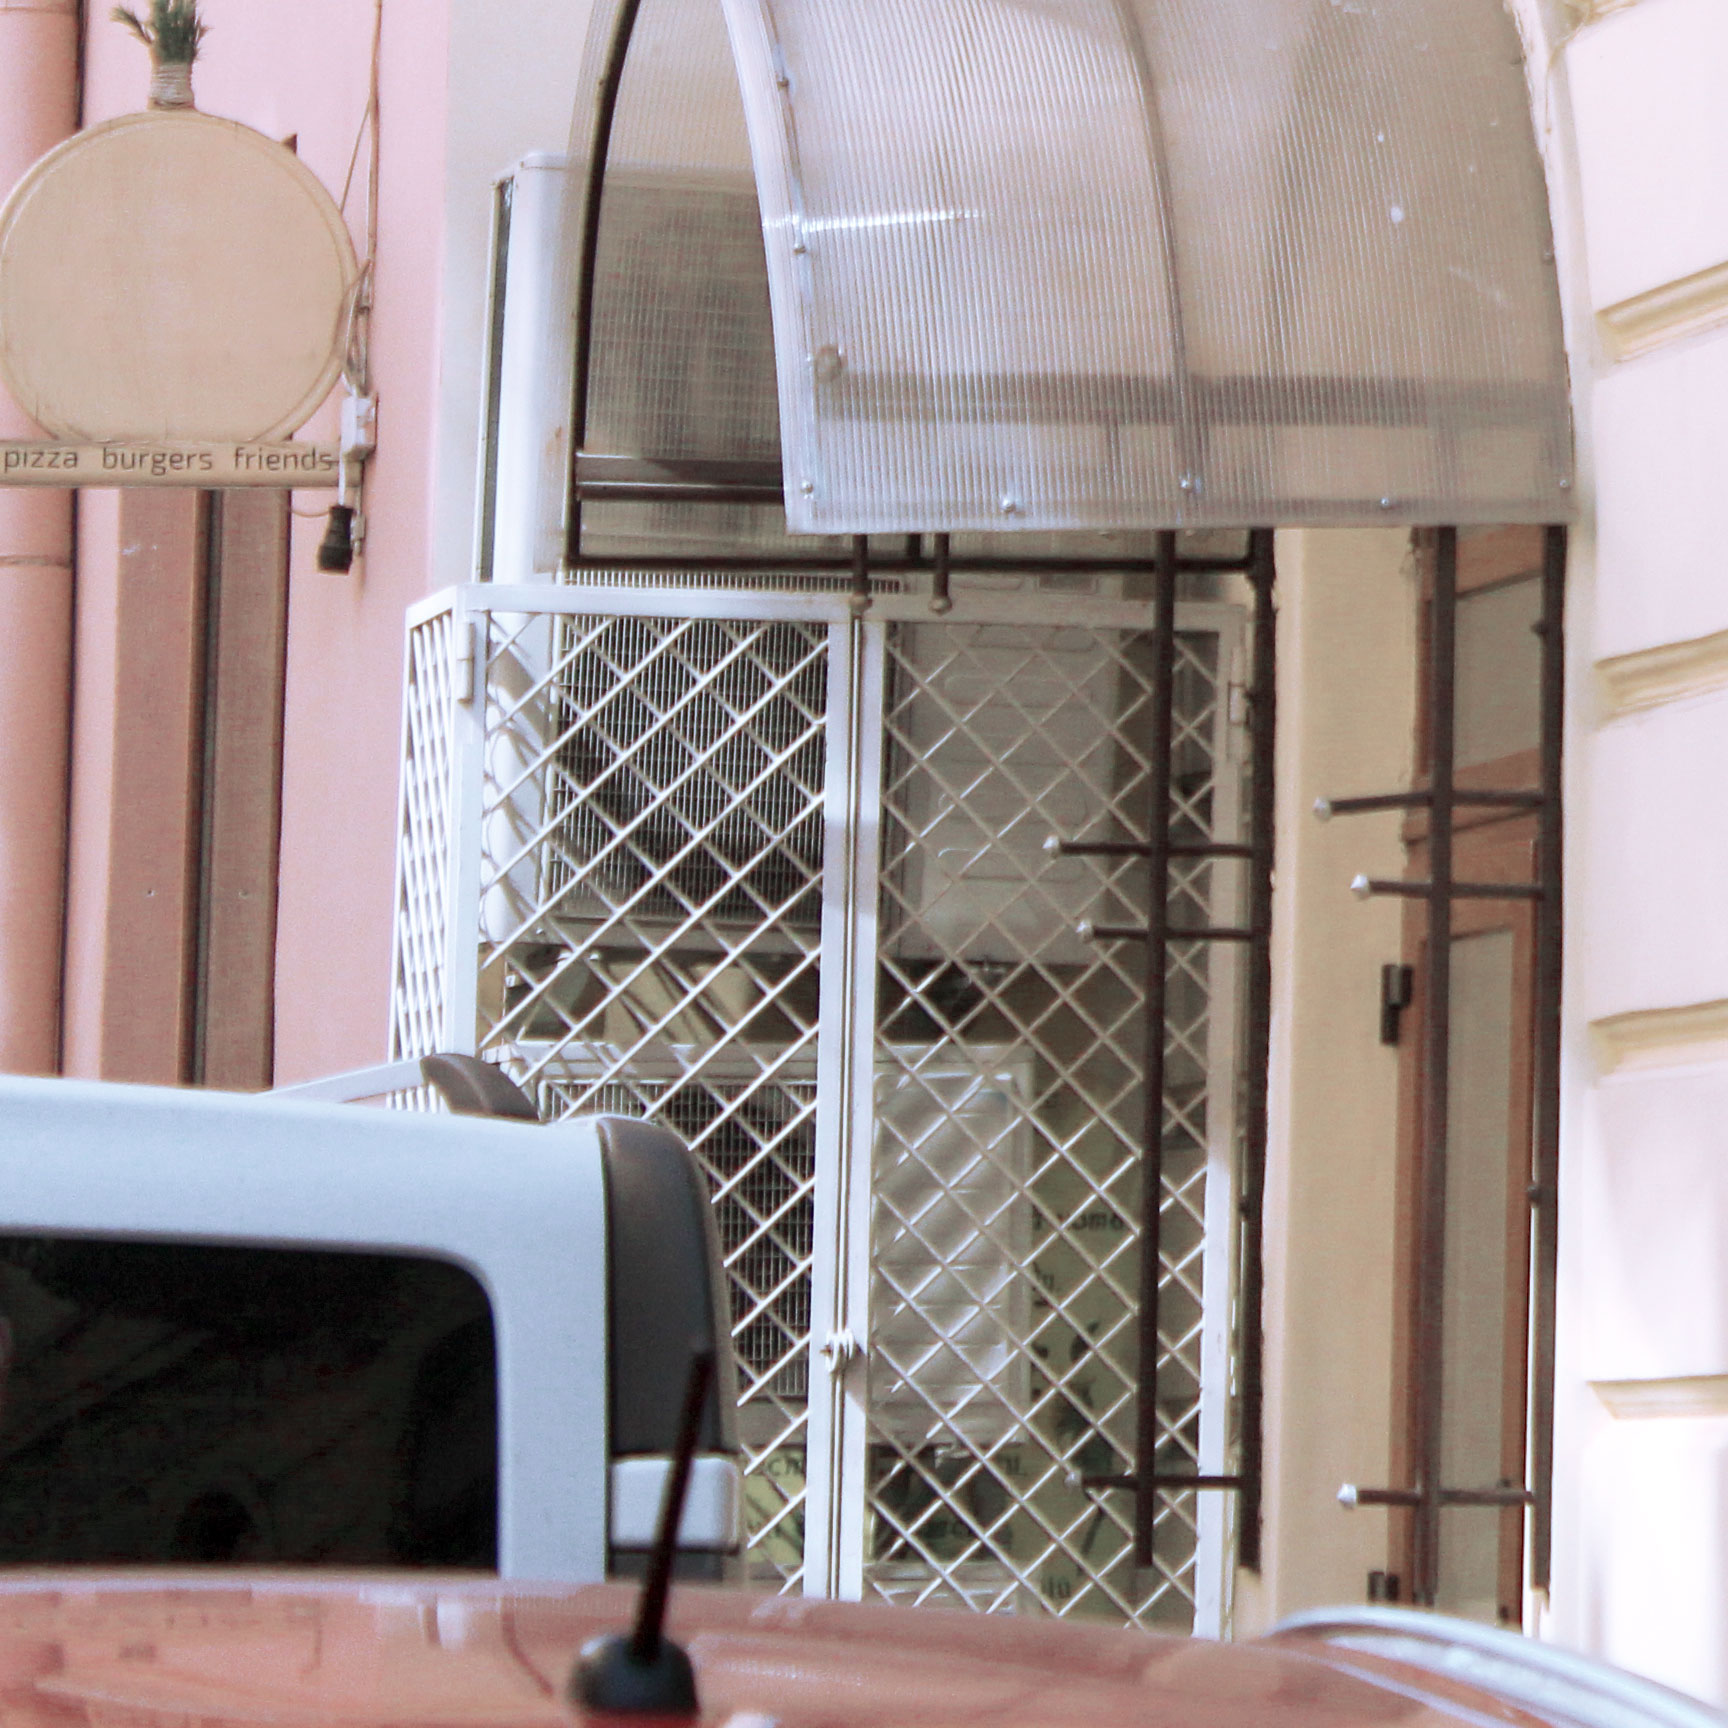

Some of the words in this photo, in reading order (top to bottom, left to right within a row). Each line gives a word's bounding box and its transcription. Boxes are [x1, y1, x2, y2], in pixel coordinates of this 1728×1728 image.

[4, 449, 79, 474] pizza
[102, 446, 213, 477] burgers
[233, 446, 333, 471] friends
